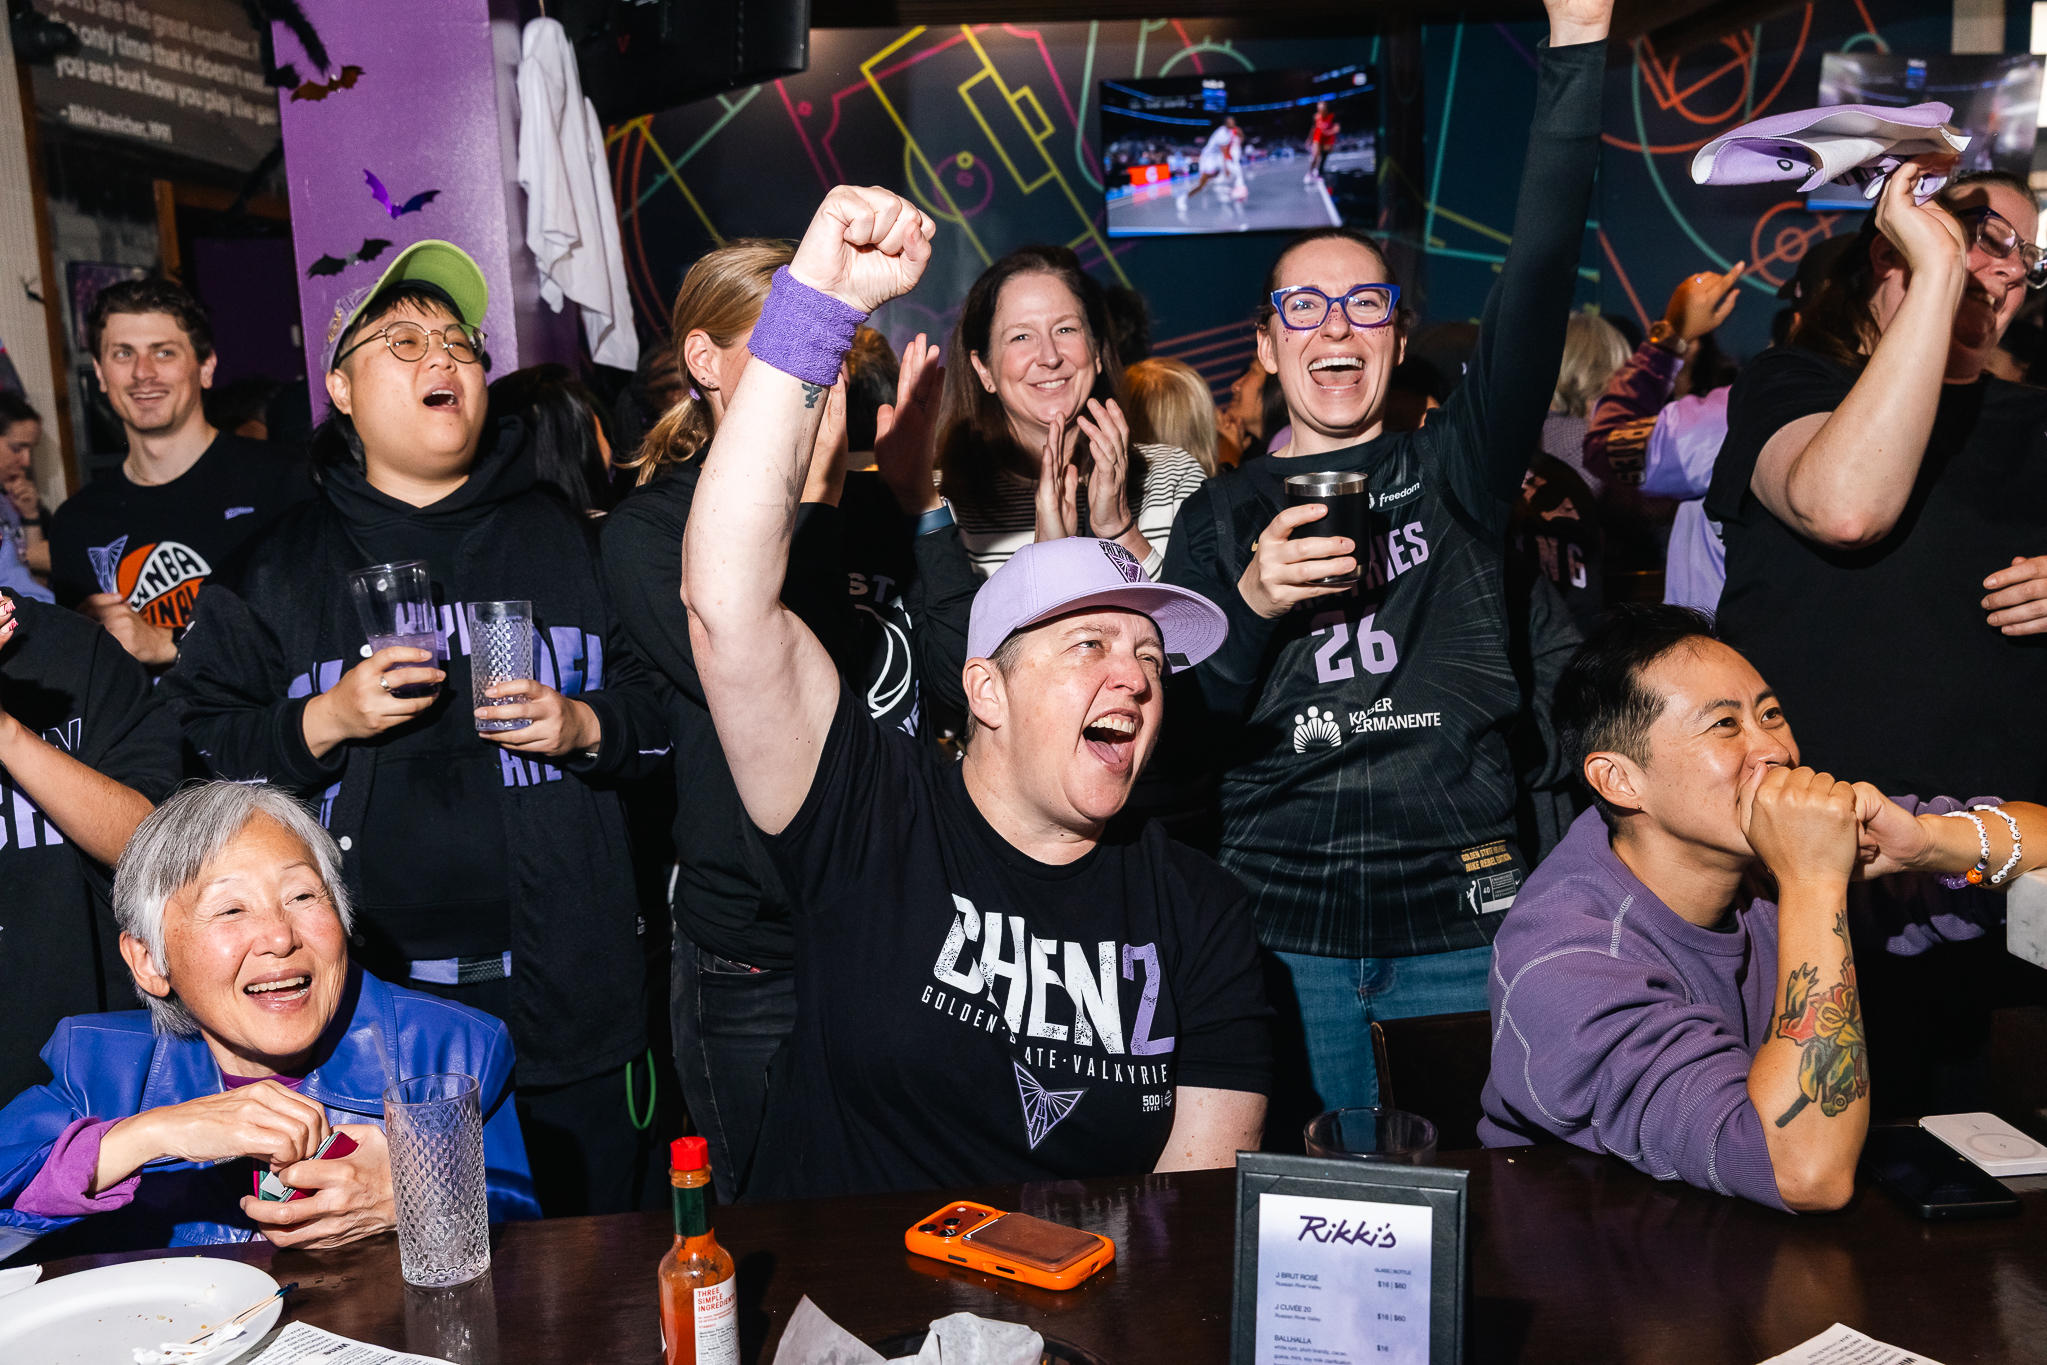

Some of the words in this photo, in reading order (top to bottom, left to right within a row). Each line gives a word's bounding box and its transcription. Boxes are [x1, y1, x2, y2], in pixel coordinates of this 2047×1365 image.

[1379, 482, 1420, 508] freedom
[131, 546, 203, 609] WNBA
[1311, 603, 1399, 684] 26
[1351, 711, 1442, 734] ERMANENTE
[1073, 1054, 1168, 1085] VALKYRIE
[1142, 1094, 1160, 1107] 500
[1298, 1215, 1396, 1249] Rikki's
[1281, 1272, 1299, 1280] BRUT
[698, 1287, 720, 1297] THREE
[698, 1292, 723, 1305] SIMPLE
[1274, 1334, 1312, 1344] BALLHALLA
